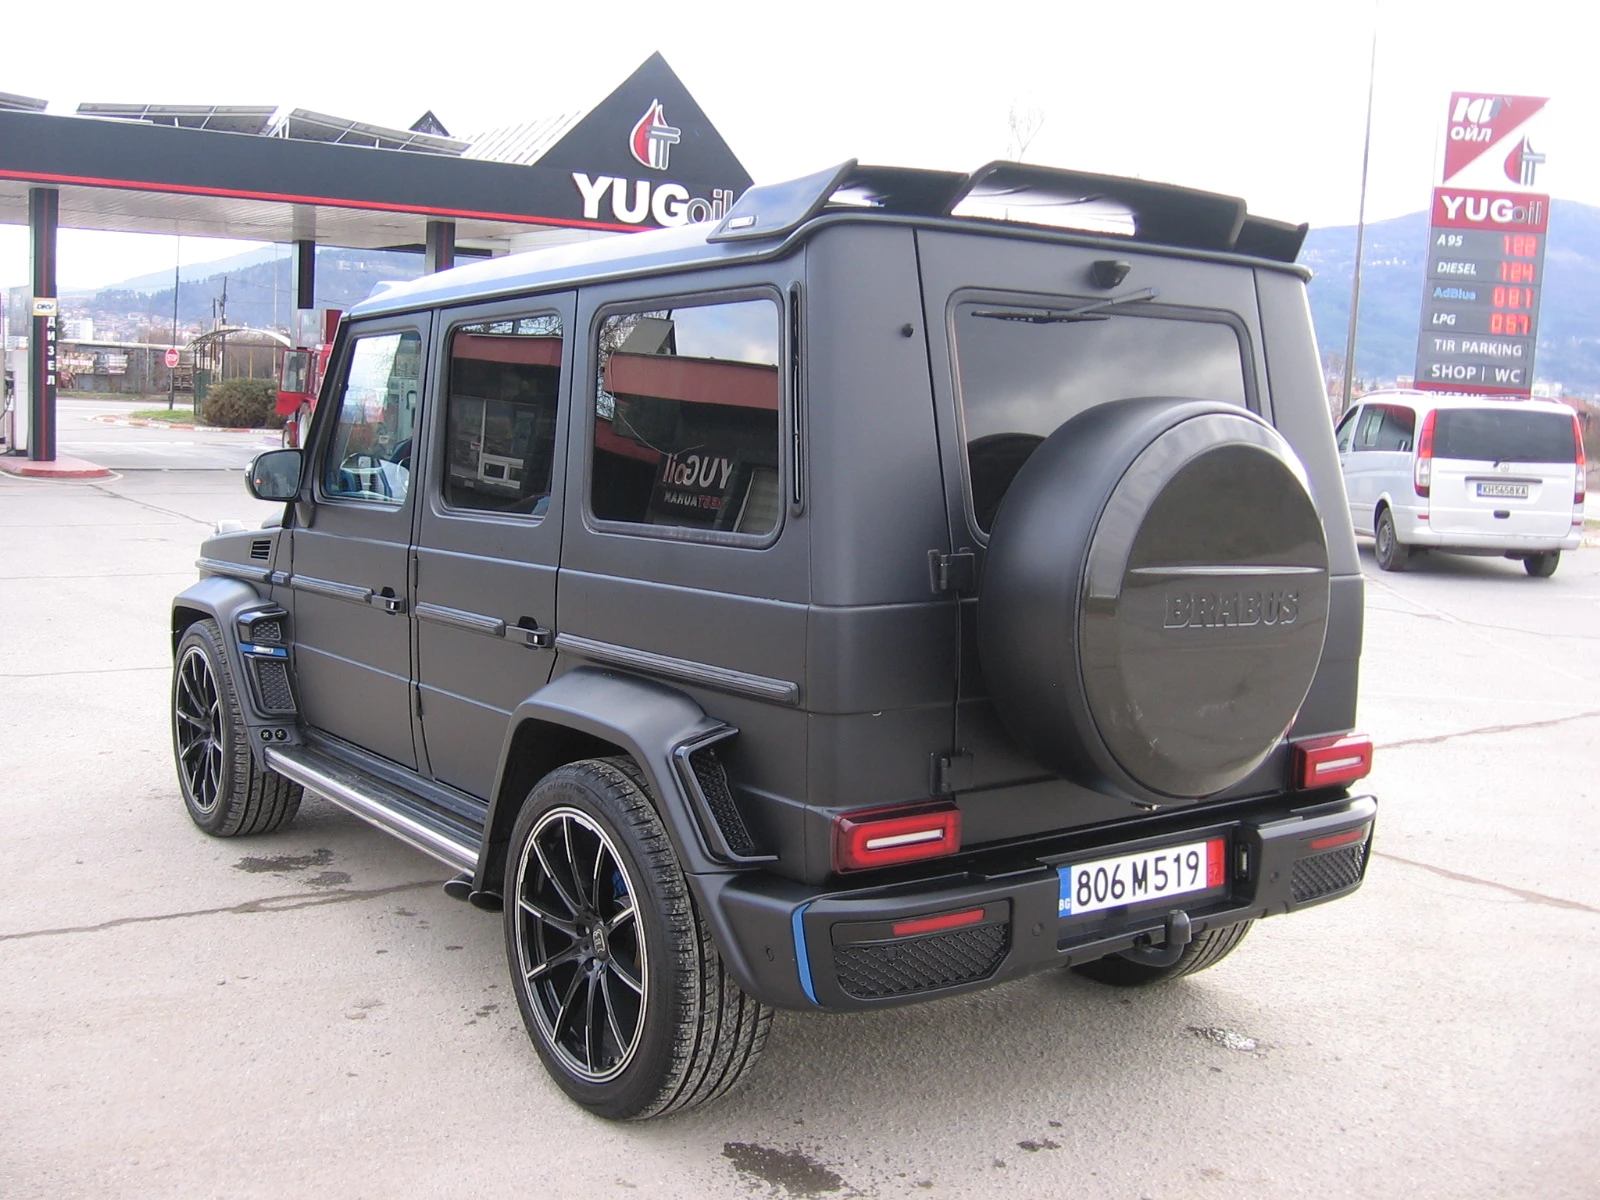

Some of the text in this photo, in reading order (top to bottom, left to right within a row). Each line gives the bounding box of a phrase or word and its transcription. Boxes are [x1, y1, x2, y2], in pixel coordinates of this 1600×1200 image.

[1437, 261, 1477, 276] DIESEL
[1433, 286, 1476, 301] AdBlue
[36, 303, 54, 311] DKV
[1432, 312, 1457, 326] LPG
[46, 317, 56, 385] ДИЗЕЛ
[1434, 338, 1523, 357] TIR PARKING
[1431, 364, 1521, 383] SHOP WC
[1164, 590, 1299, 629] BRABUS
[1058, 898, 1071, 911] BG
